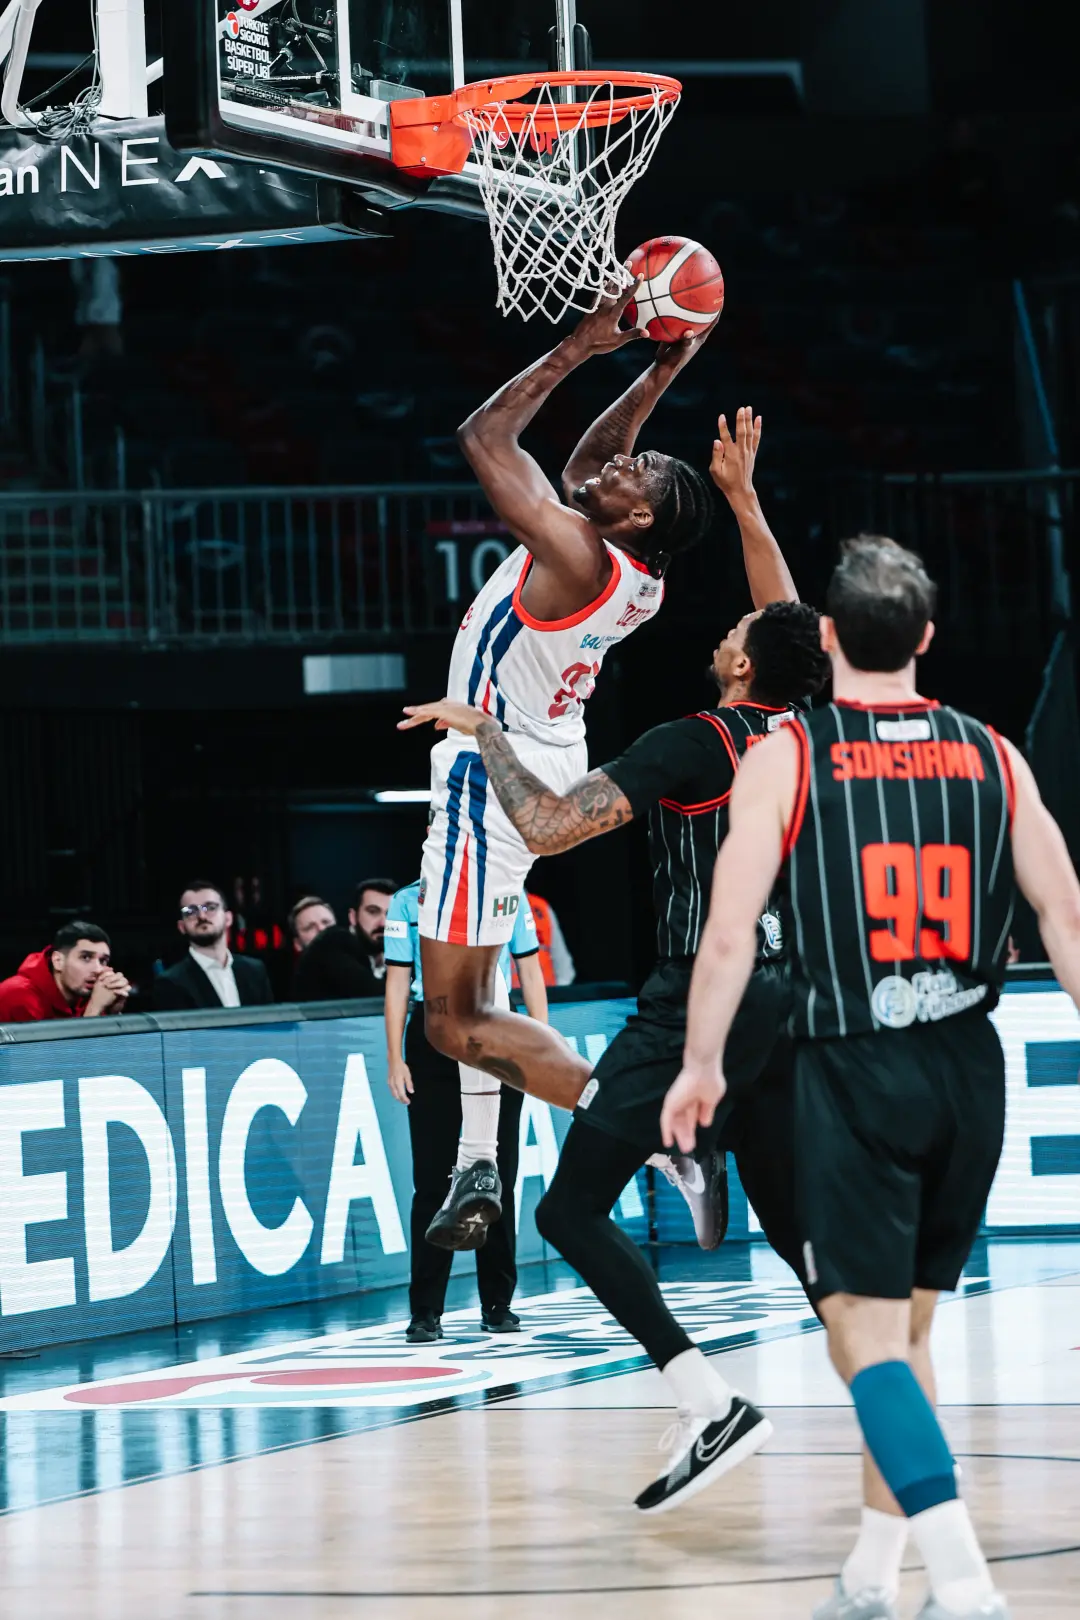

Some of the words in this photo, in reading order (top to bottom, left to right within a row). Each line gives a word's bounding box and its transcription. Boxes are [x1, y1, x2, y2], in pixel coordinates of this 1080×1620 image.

[240, 28, 270, 47] SİGORTA
[225, 39, 271, 63] BASKETBOL
[228, 55, 254, 75] SÜPER
[861, 842, 970, 962] 99
